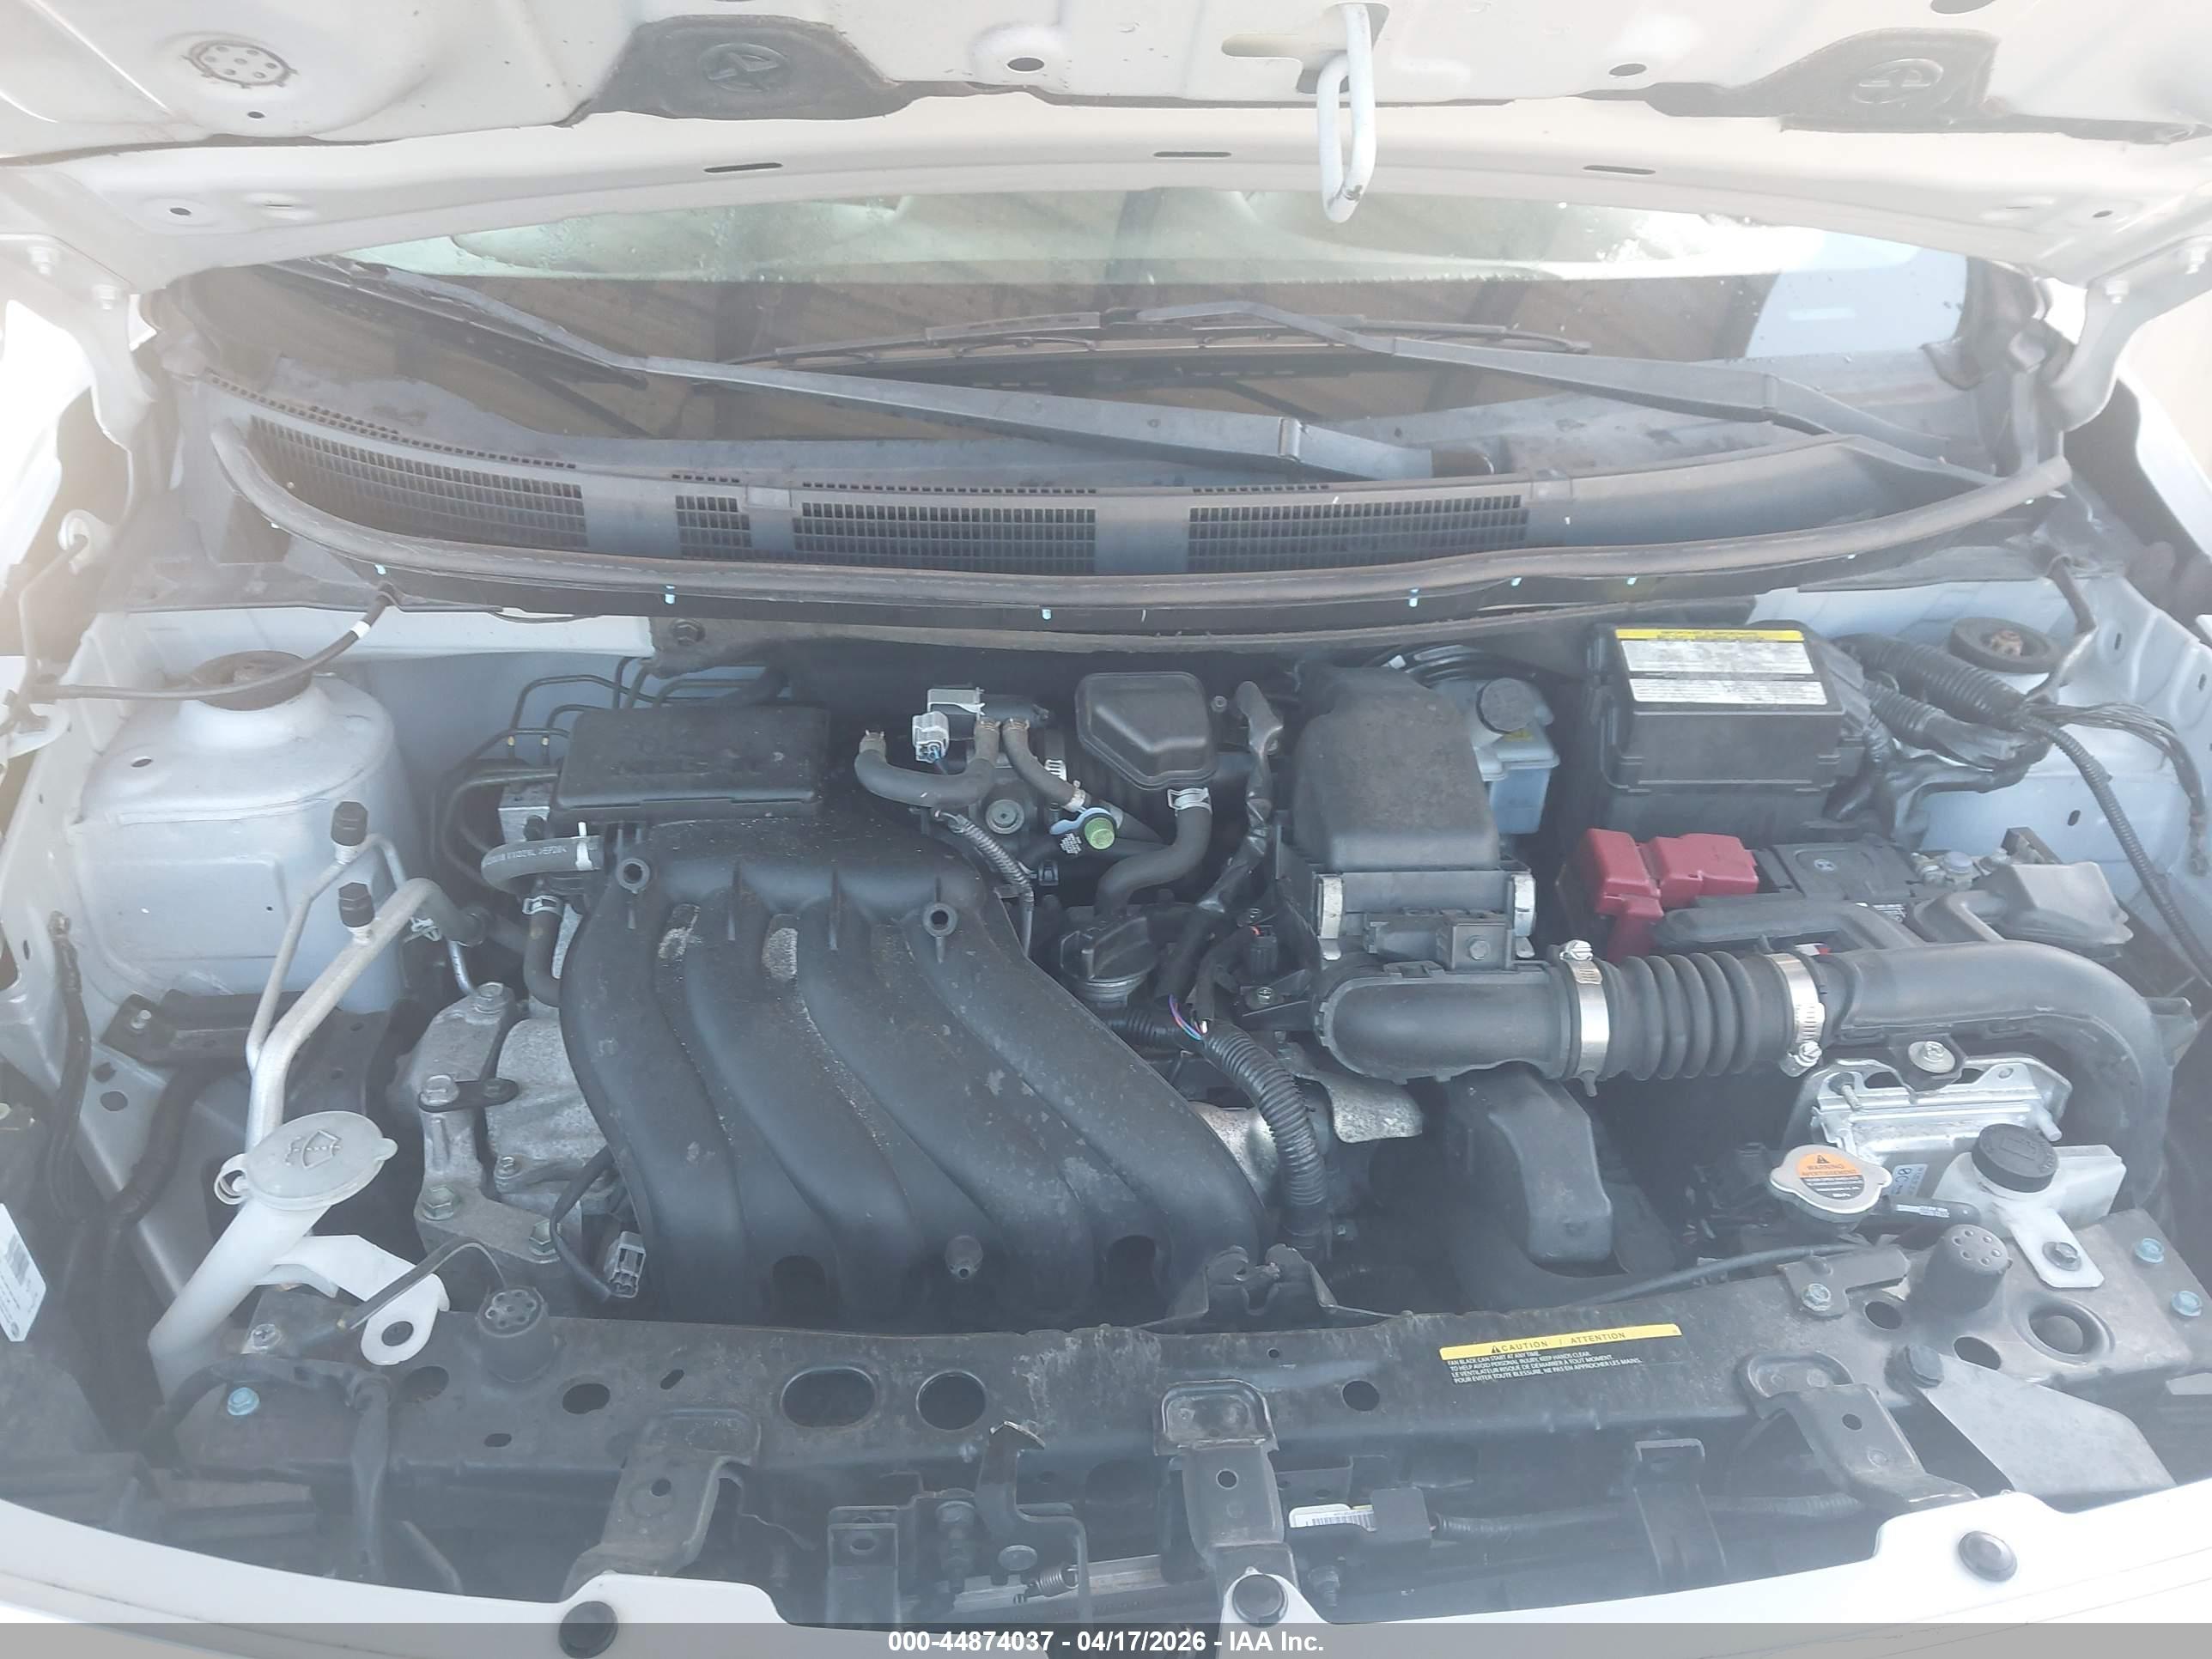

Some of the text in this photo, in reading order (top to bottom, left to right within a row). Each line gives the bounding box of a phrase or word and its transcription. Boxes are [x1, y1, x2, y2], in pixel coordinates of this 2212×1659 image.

[1502, 1341, 1548, 1352] CAUTION
[1571, 1333, 1626, 1344] ATTENTION
[1492, 1359, 1518, 1368] PERSONAL
[1573, 1361, 1609, 1370] APPROCHER
[1460, 1367, 1498, 1376] VENTILATEUR
